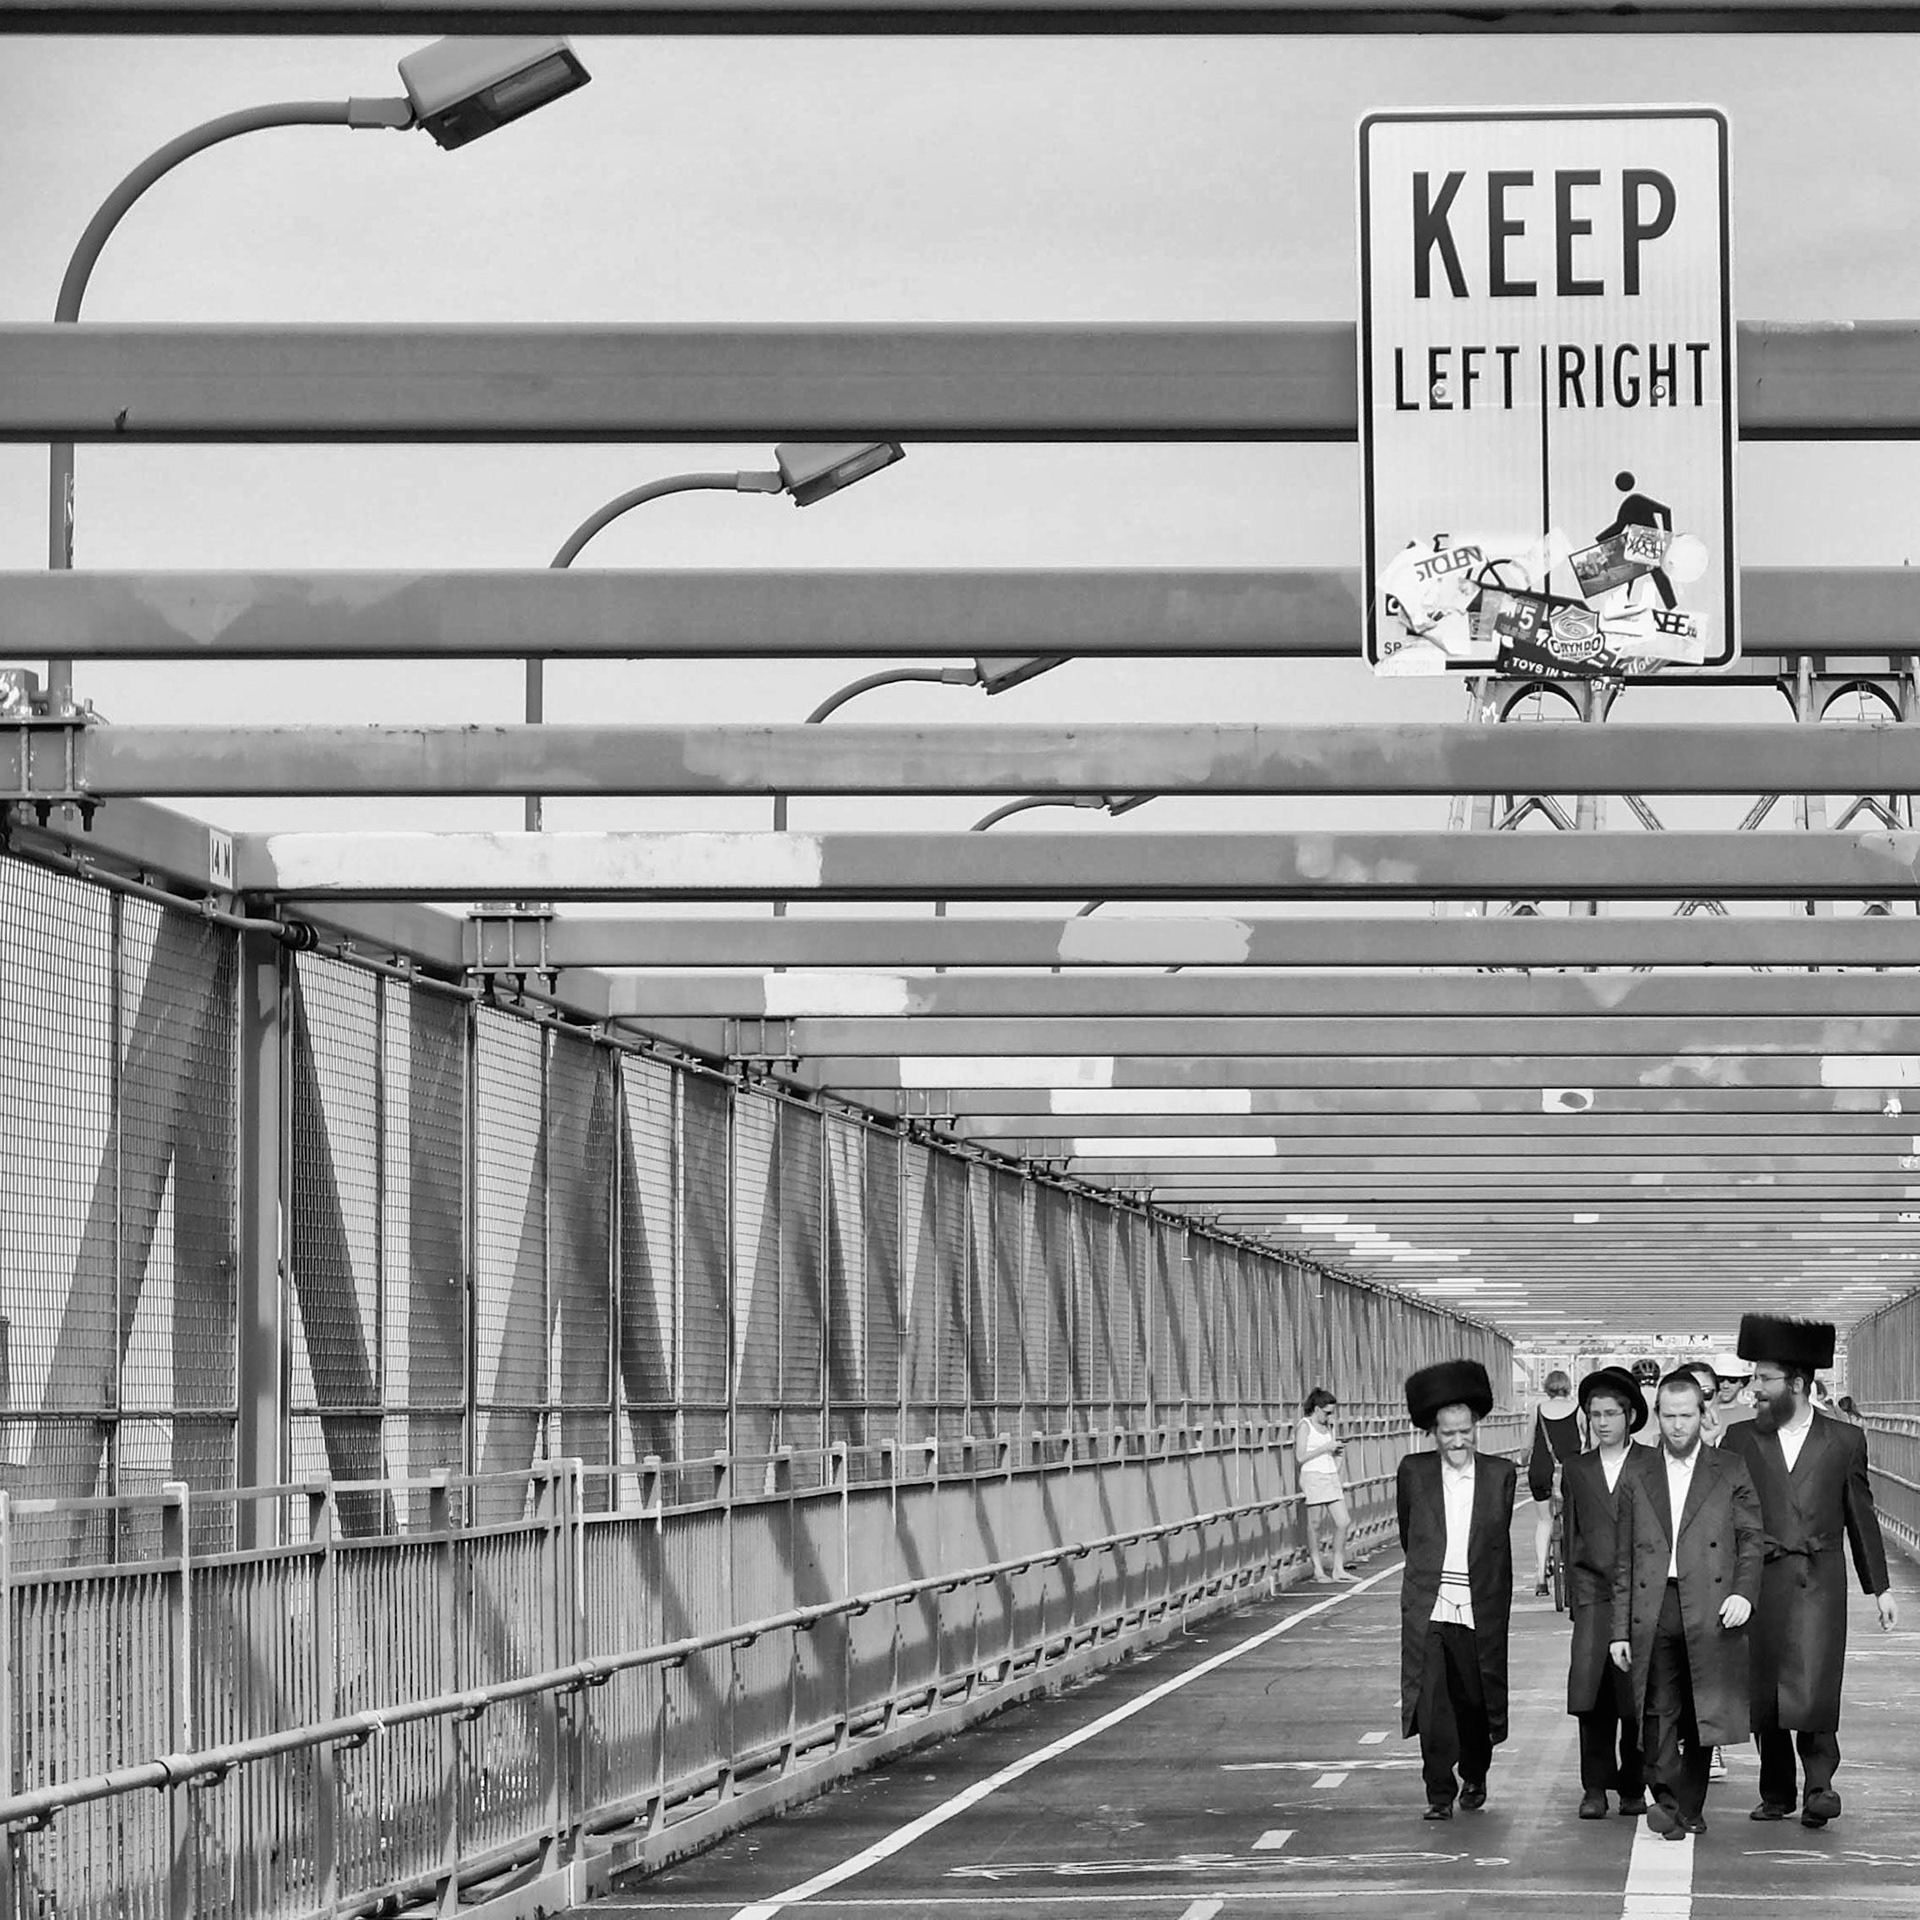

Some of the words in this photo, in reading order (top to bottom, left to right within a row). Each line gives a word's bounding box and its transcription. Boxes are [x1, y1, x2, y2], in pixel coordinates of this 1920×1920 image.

[1412, 168, 1676, 298] KEEP
[1394, 346, 1519, 411] LEFT
[1558, 343, 1710, 408] RIGHT
[1512, 657, 1544, 674] TOYS
[1545, 666, 1559, 678] IN
